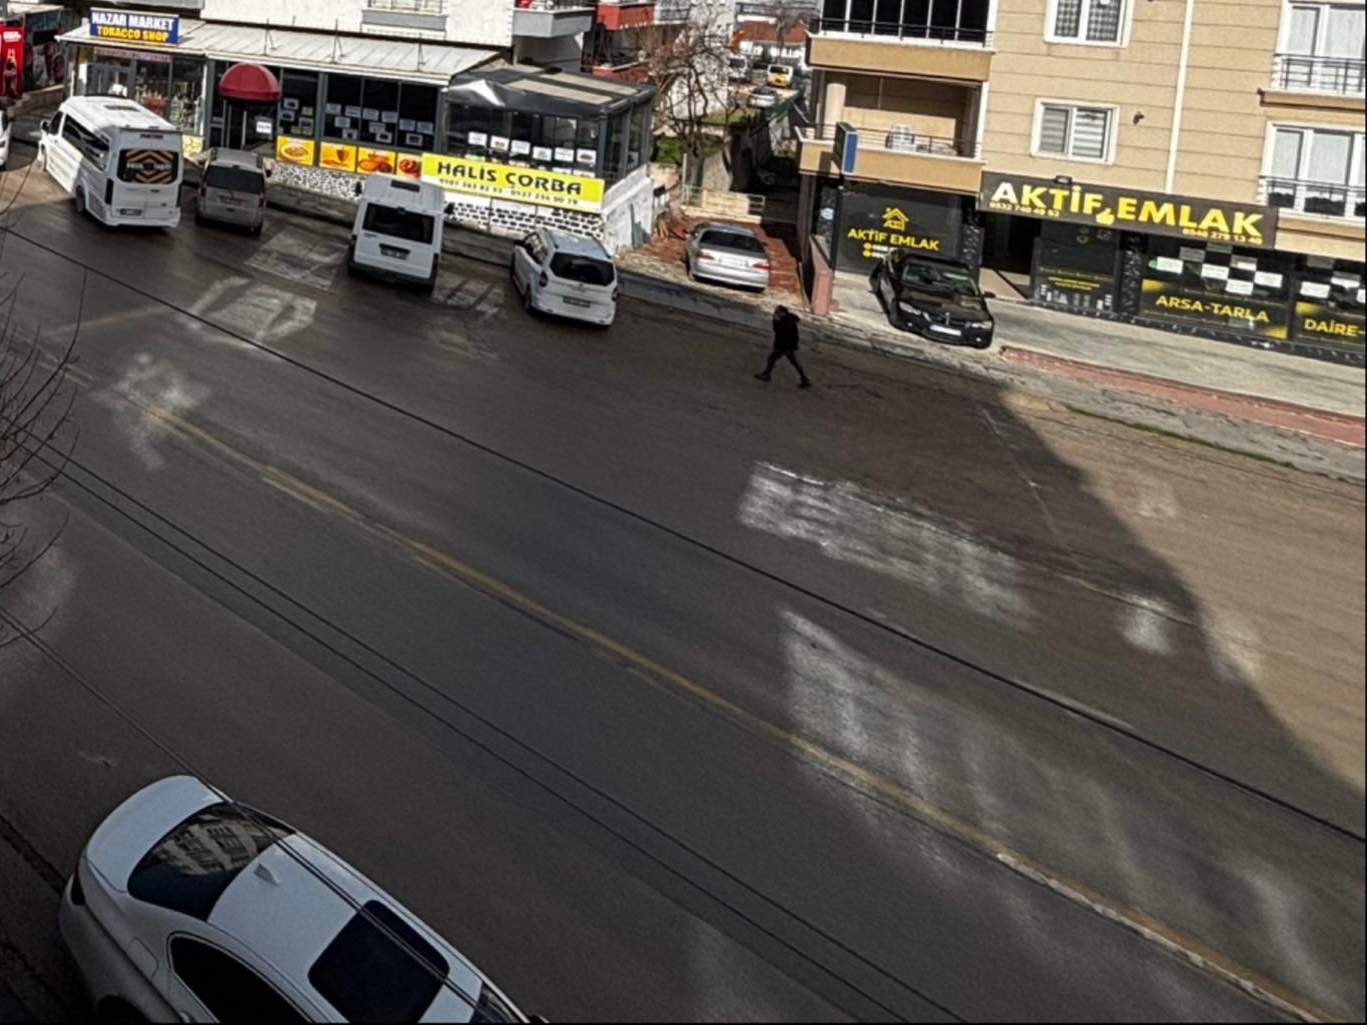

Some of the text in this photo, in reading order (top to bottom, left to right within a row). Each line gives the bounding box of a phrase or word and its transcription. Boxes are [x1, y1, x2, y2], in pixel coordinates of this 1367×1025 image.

[91, 12, 175, 31] NAZAR MARKET
[98, 26, 169, 42] TOBACCO SHOP
[437, 161, 582, 196] HALİS ÇORBA
[990, 181, 1264, 237] AKTİF EMLAK
[847, 228, 939, 251] AKTİF EMLAK
[1156, 295, 1270, 323] ARSA-TARLA
